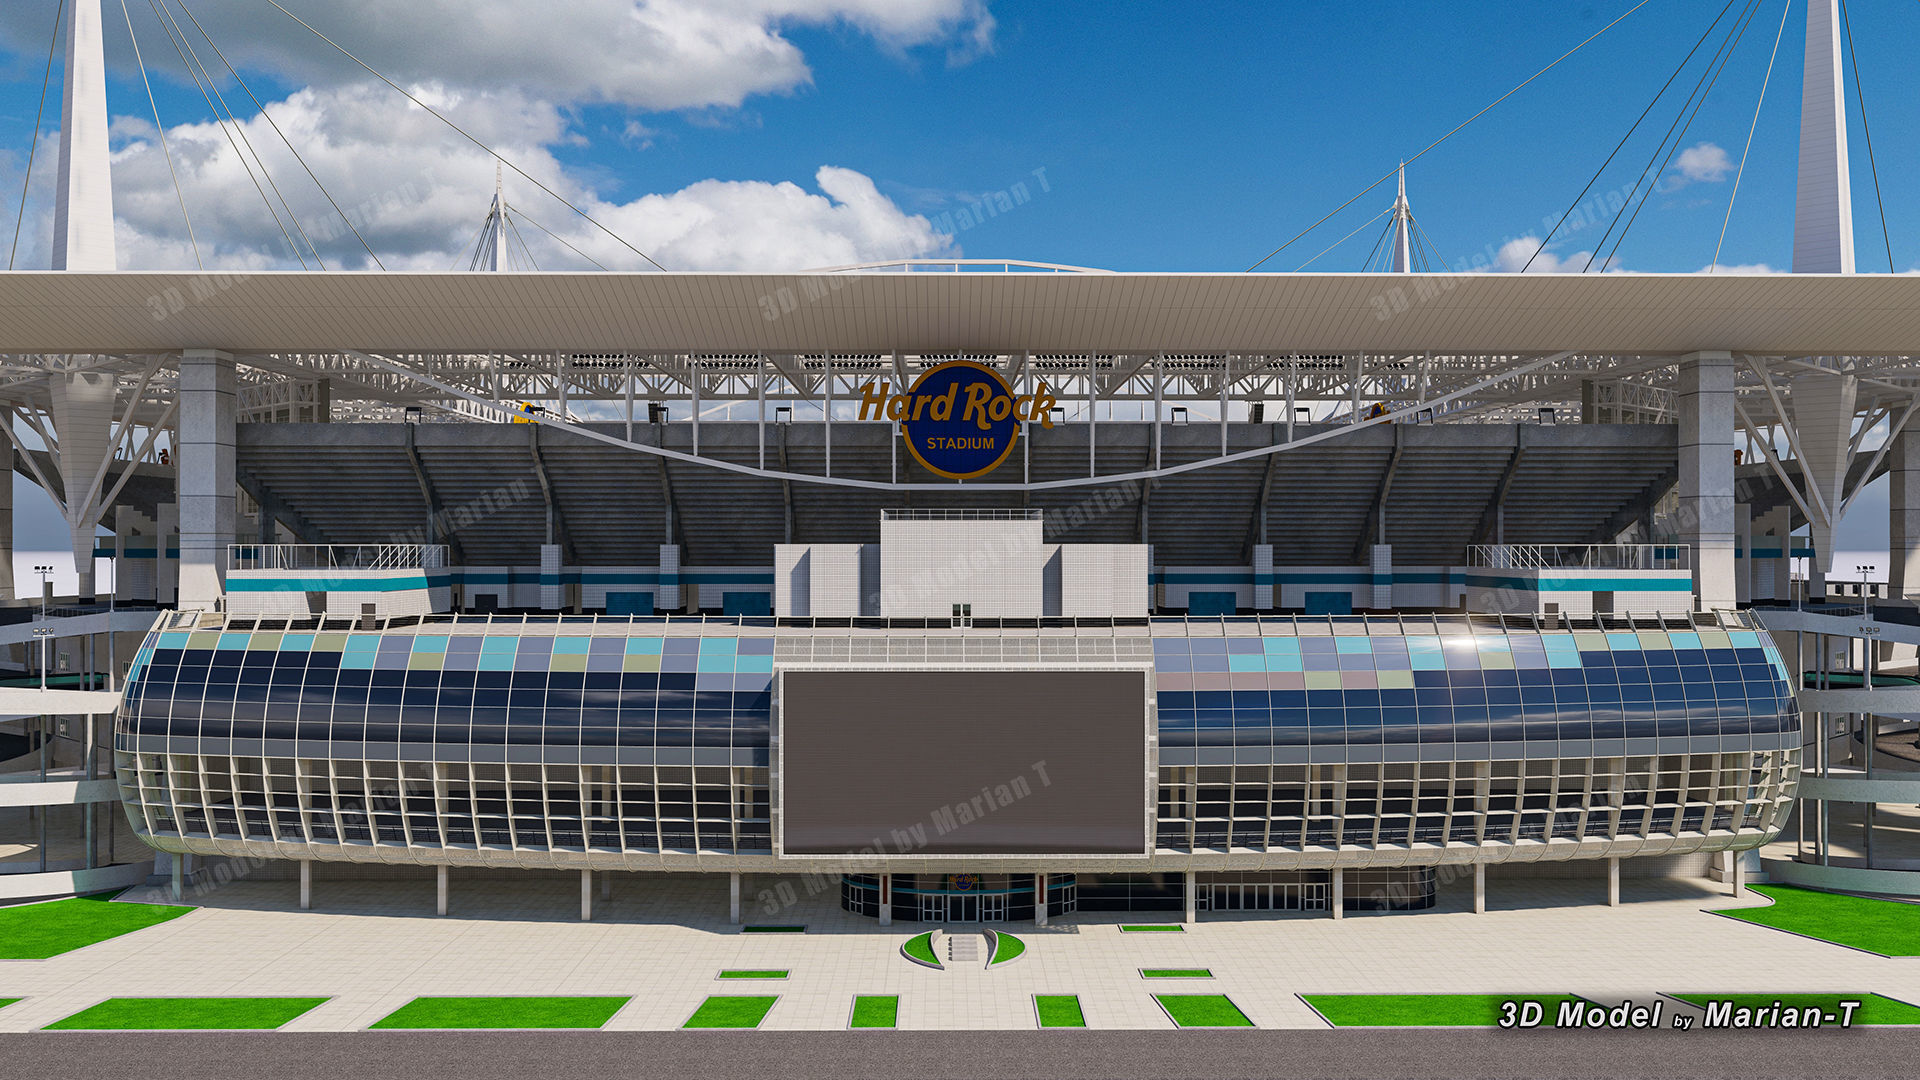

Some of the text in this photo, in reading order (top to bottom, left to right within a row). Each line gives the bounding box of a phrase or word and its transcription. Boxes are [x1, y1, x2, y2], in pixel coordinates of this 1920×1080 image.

[858, 382, 1056, 430] Hard Rock
[927, 437, 995, 449] STADIUM
